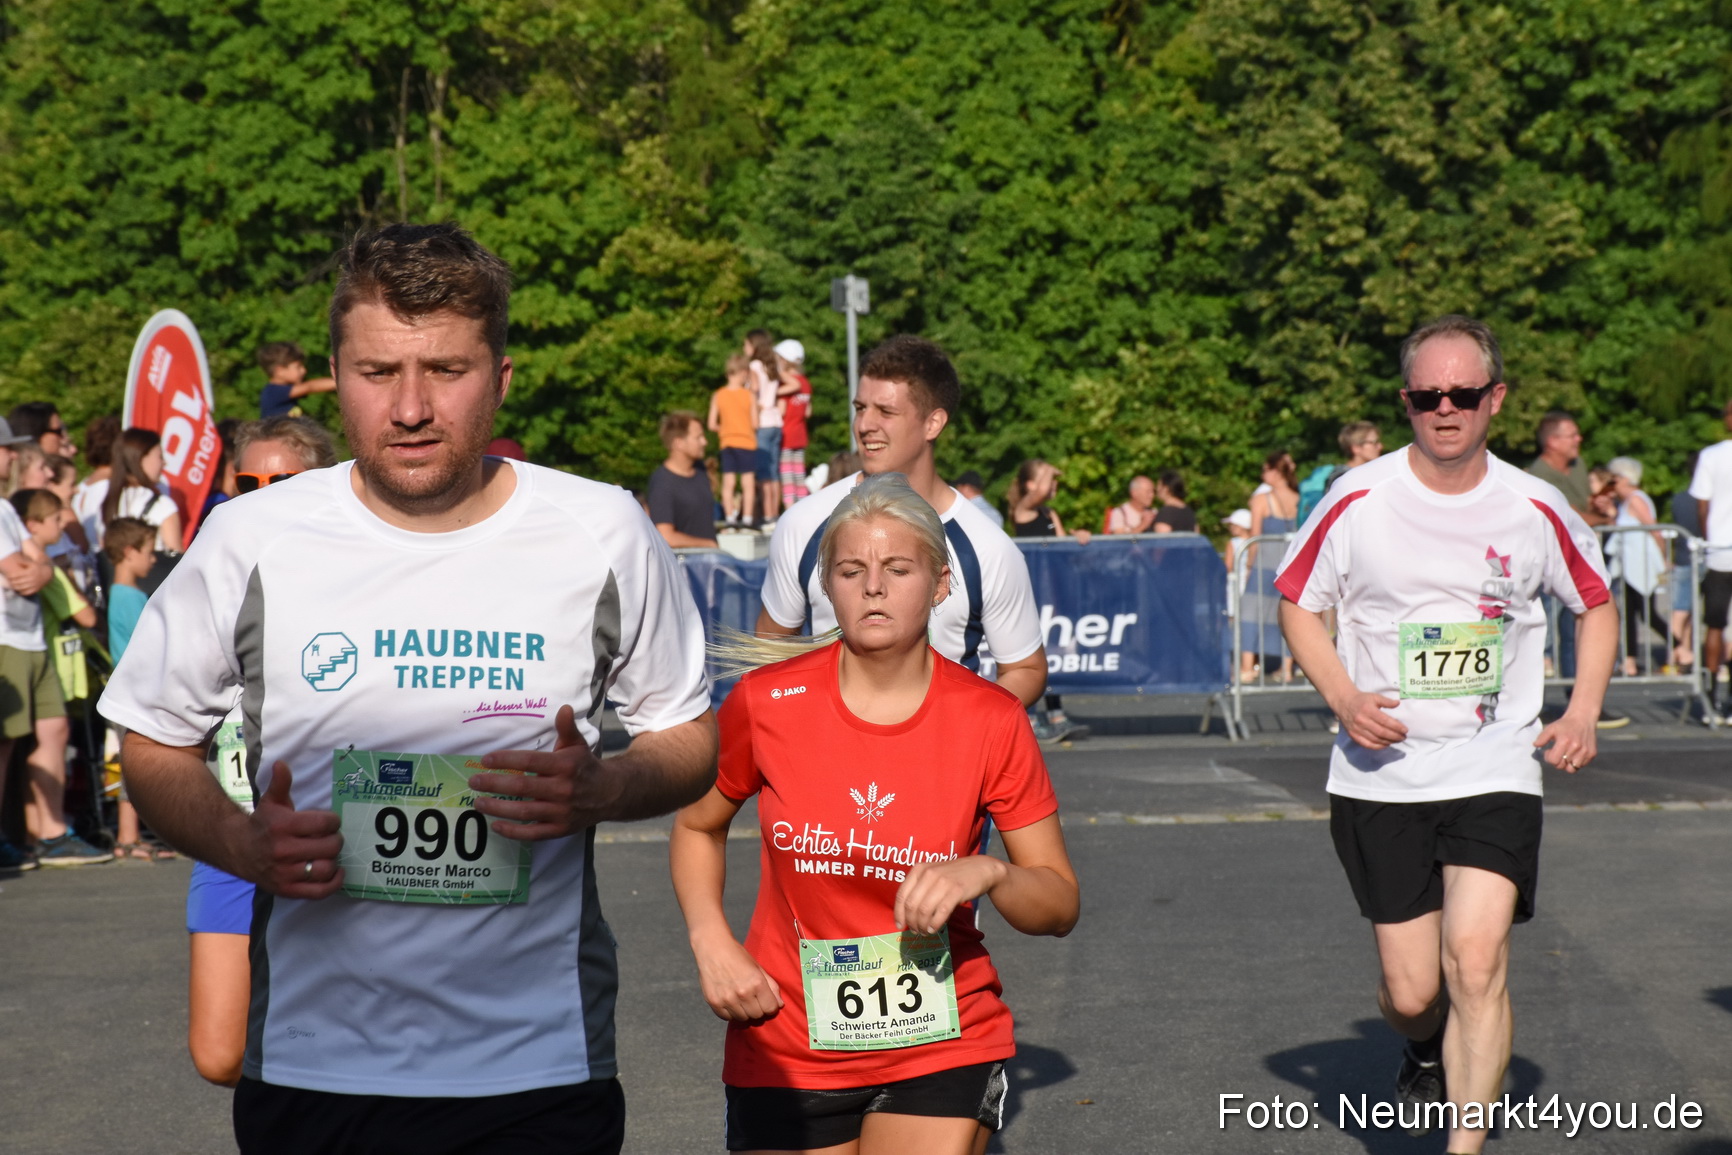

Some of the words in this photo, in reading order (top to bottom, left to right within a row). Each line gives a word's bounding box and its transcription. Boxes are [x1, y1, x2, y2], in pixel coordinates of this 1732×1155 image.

[374, 629, 546, 661] HAUBNER
[1414, 648, 1490, 676] 1778
[394, 664, 524, 691] TREPPEN
[1409, 678, 1463, 686] Bodensteiner
[1465, 674, 1494, 684] Gerhard
[783, 686, 807, 697] JAKO
[524, 697, 547, 709] Wahl
[231, 751, 243, 778] 1
[363, 779, 443, 797] firmenlauf
[375, 806, 488, 862] 990
[772, 820, 843, 856] Echtes
[371, 860, 441, 877] Bömoser
[445, 864, 491, 878] Marco
[794, 858, 855, 877] IMMER
[863, 866, 906, 883] FRIS
[386, 877, 440, 889] HAUBNER
[442, 880, 475, 890] GmbH
[824, 957, 883, 972] firmenlauf
[837, 973, 923, 1019] 613
[831, 1021, 887, 1031] Schwiertz
[890, 1013, 936, 1028] Amanda
[839, 1032, 853, 1040] Der
[855, 1032, 882, 1040] Bäcker
[905, 1025, 929, 1035] GmbH
